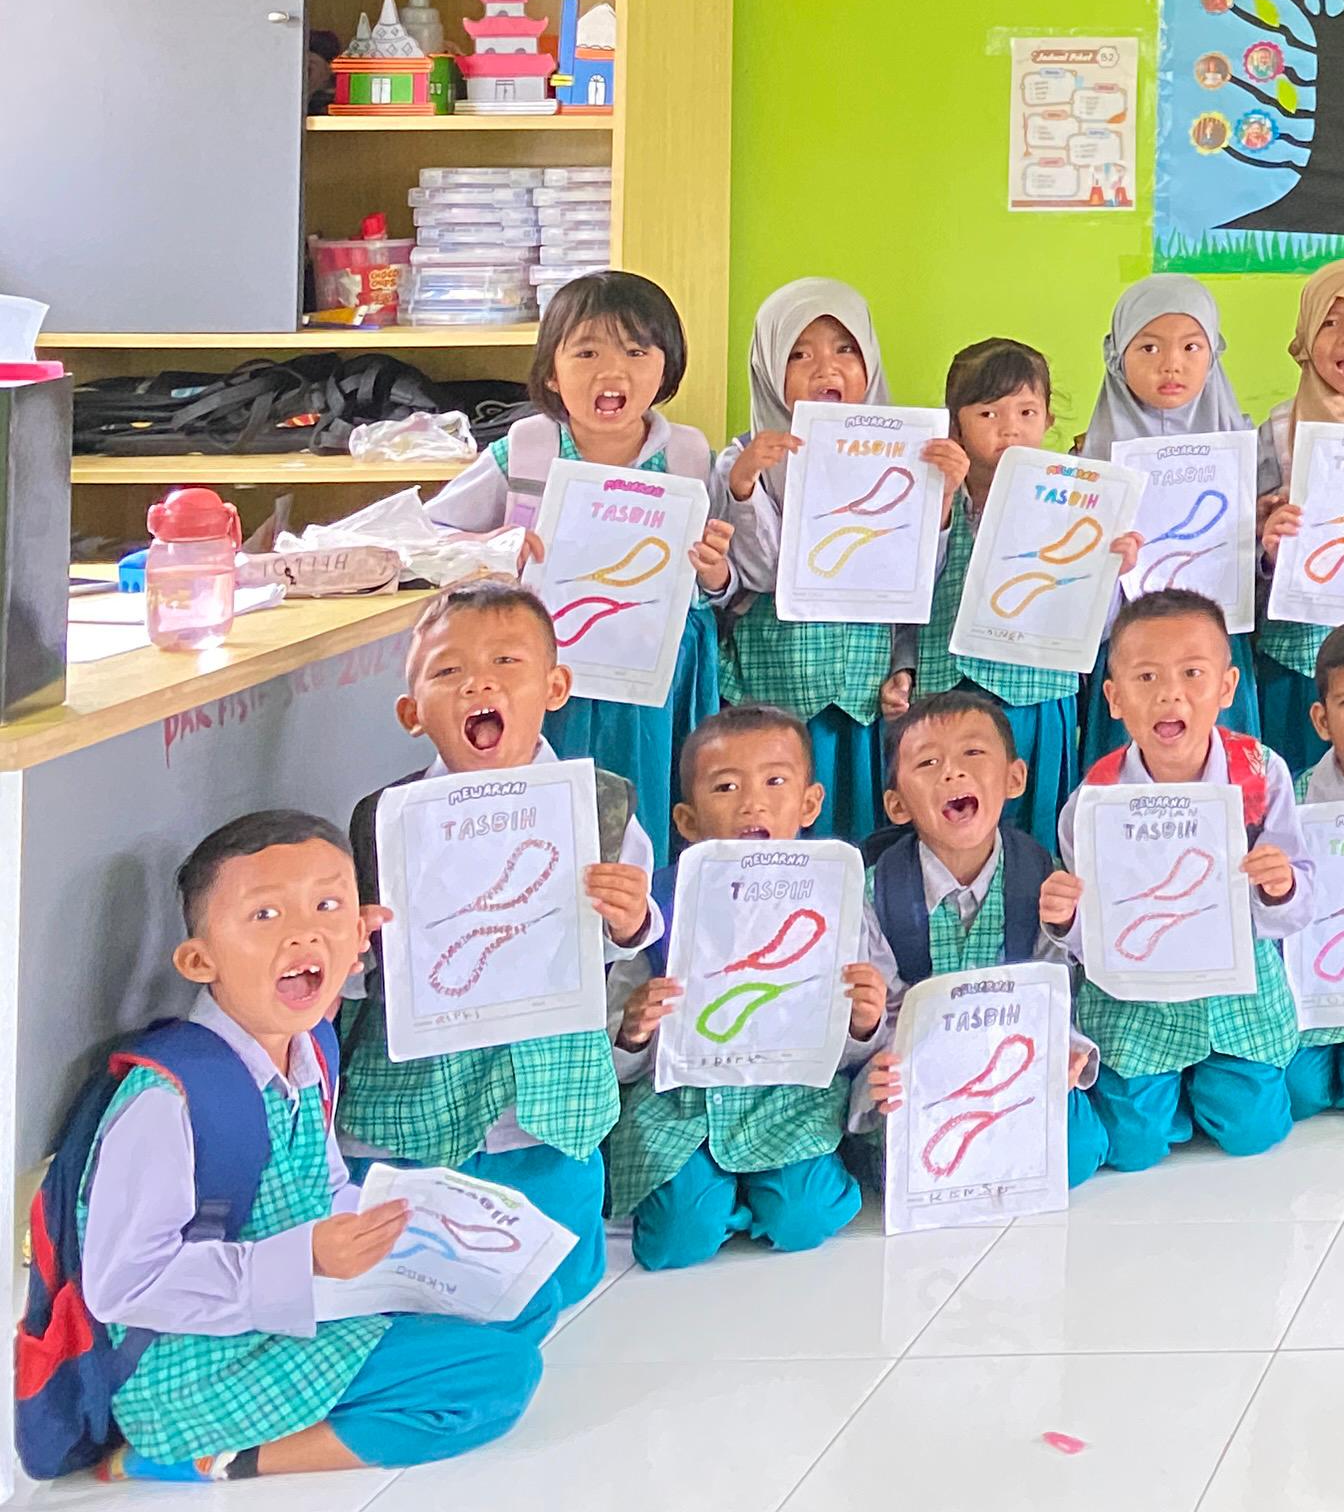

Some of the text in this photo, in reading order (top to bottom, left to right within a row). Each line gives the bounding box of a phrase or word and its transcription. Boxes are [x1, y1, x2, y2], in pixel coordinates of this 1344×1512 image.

[370, 269, 399, 279] CHOCO
[845, 415, 903, 430] MEWARNAI
[1157, 445, 1210, 460] MEWARNAI
[1151, 466, 1216, 485] TASBIH
[449, 782, 526, 805] MEWARNAI
[1129, 796, 1190, 810] MEWARNAI
[441, 807, 537, 840] TASBIH
[741, 853, 808, 868] MEWARNAI
[731, 880, 814, 901] TASBIH
[942, 1006, 1021, 1031] TASBIH
